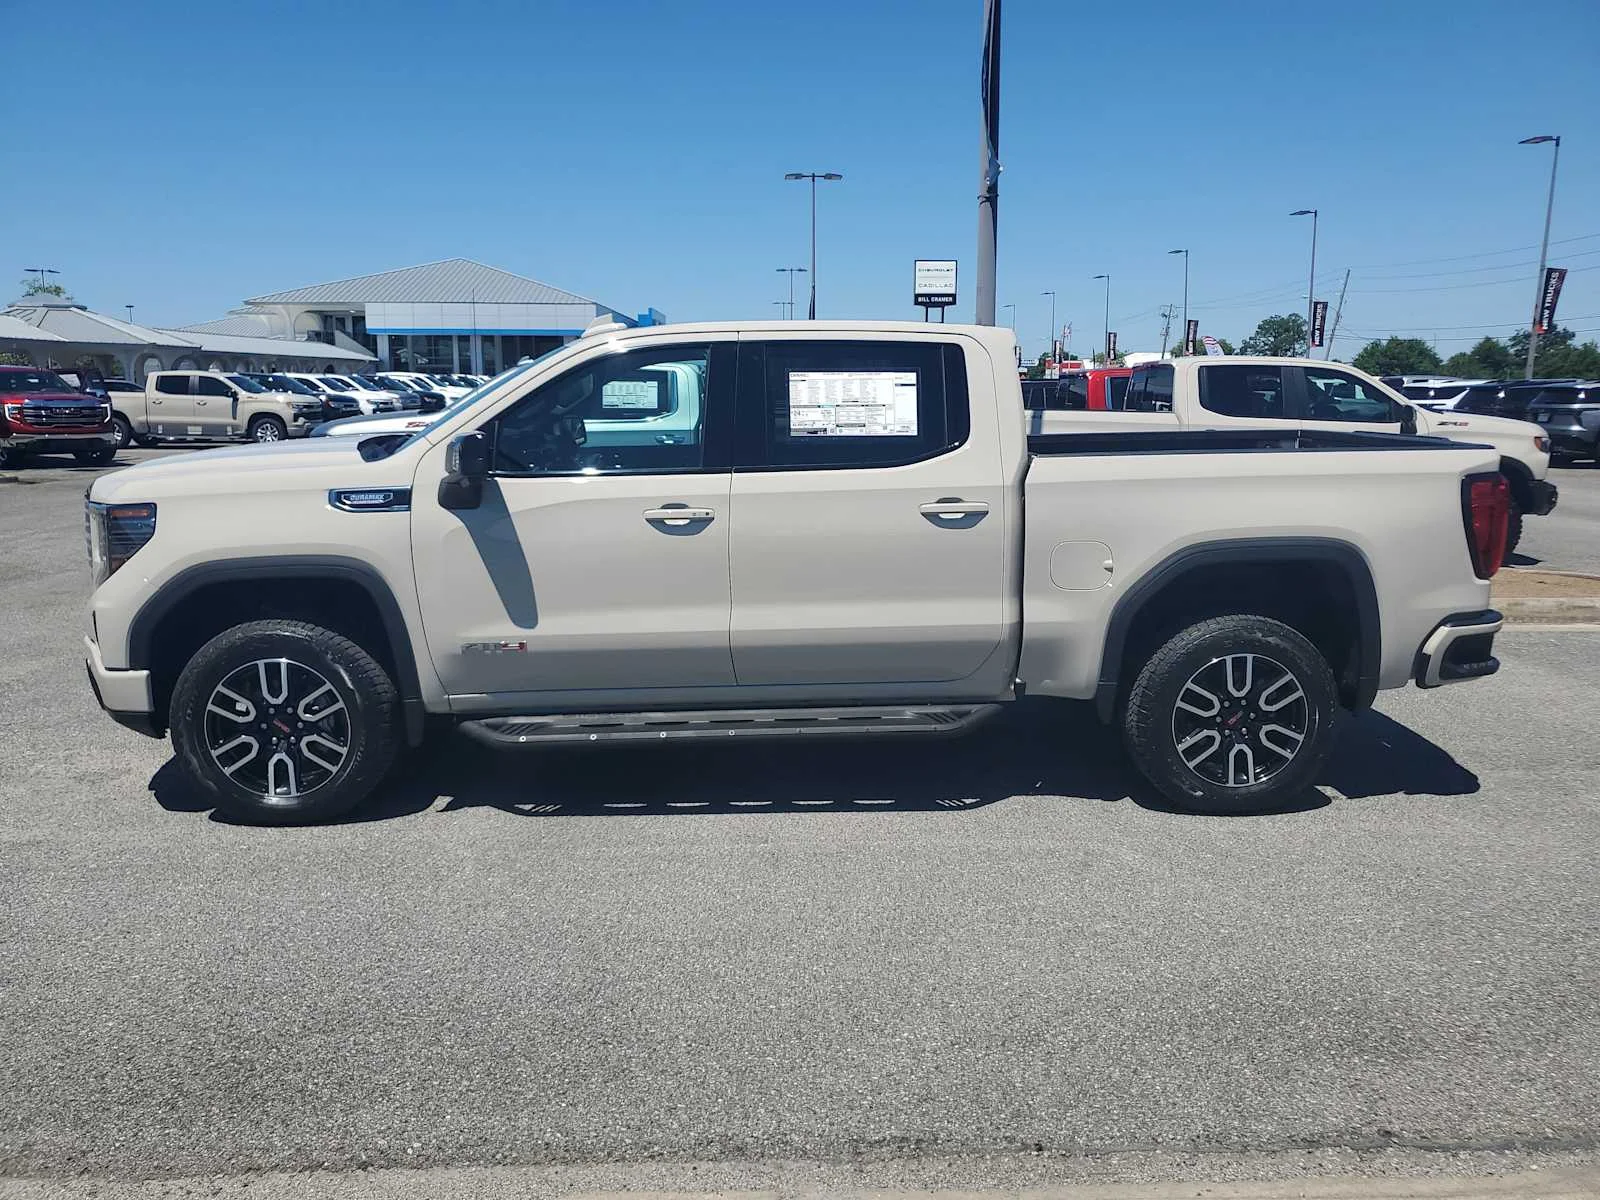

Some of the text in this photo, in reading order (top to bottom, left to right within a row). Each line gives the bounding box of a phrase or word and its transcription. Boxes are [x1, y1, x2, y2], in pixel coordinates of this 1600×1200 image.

[1315, 303, 1323, 328] TRUCKS
[1542, 271, 1560, 330] NEW TRUCKS
